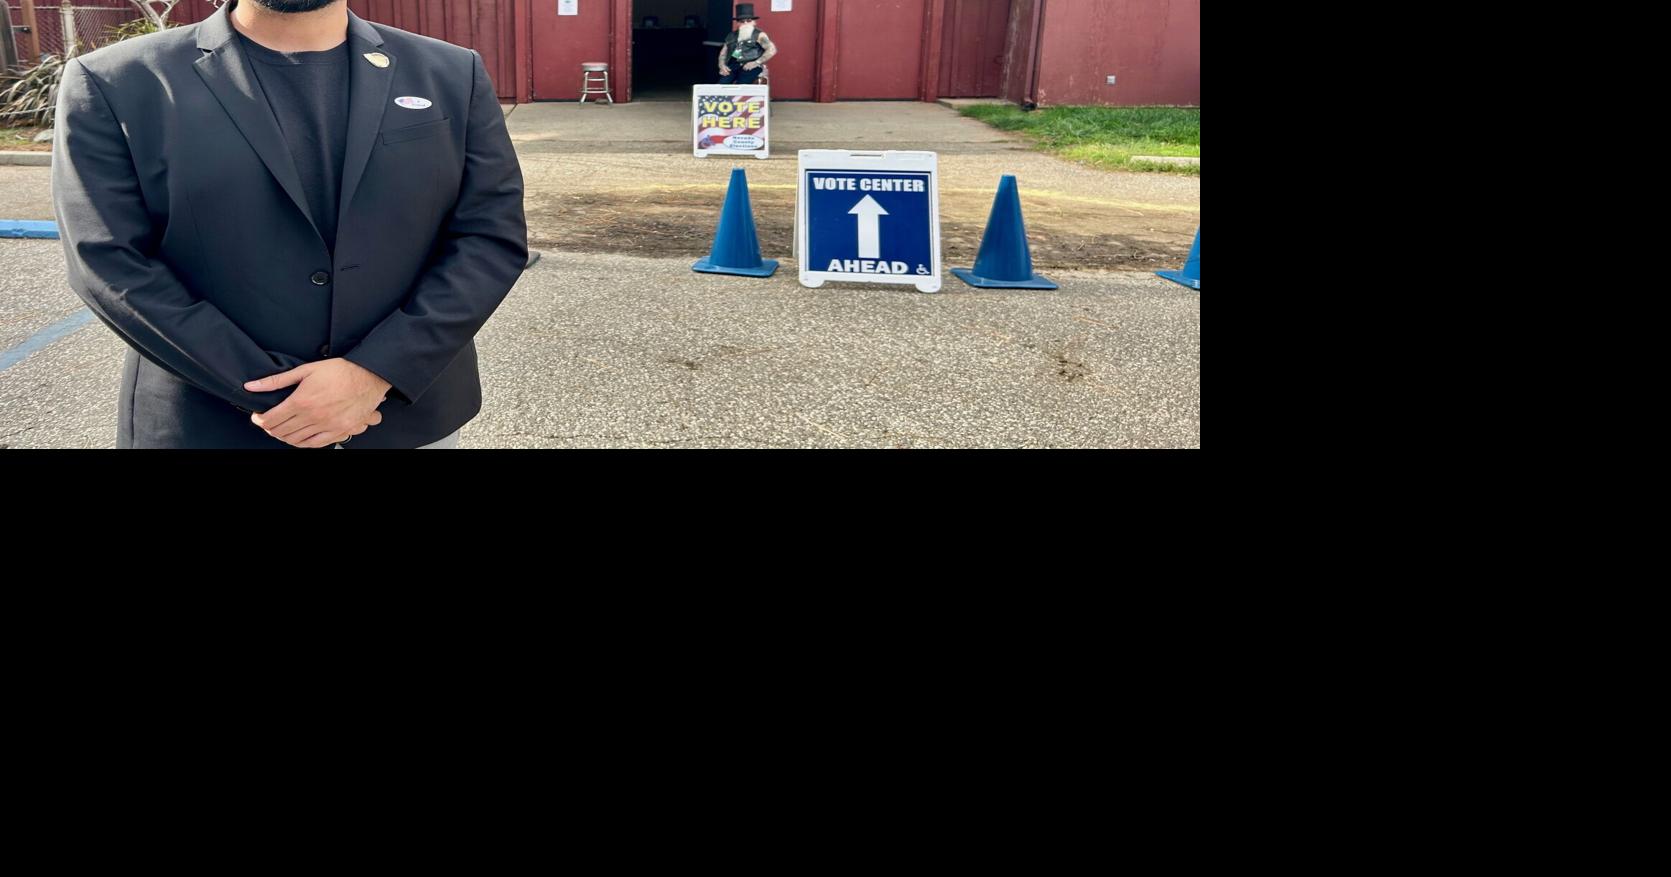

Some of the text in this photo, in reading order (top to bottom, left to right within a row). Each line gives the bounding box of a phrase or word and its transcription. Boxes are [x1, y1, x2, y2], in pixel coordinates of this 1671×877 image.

[703, 101, 761, 113] VOTE
[702, 116, 761, 129] HERE
[812, 177, 925, 192] VOTE CENTER
[827, 259, 909, 274] AHEAD
